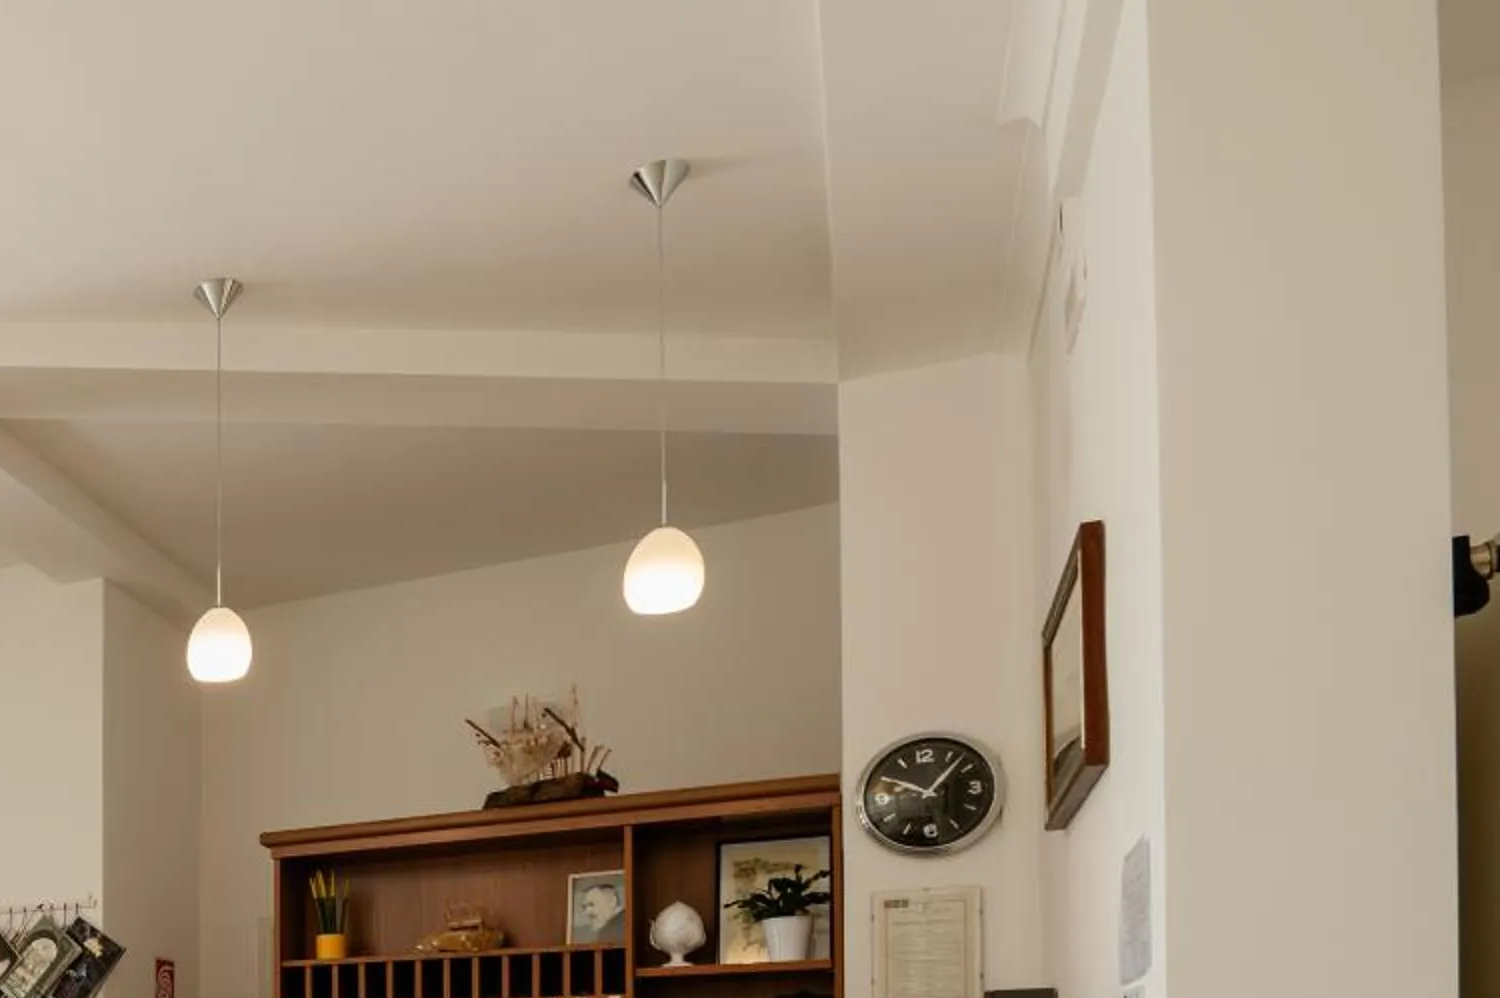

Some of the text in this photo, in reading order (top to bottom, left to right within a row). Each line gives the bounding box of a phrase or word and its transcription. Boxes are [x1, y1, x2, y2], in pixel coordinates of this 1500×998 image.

[915, 749, 935, 763] 12
[968, 781, 982, 795] 3
[923, 824, 938, 838] 6
